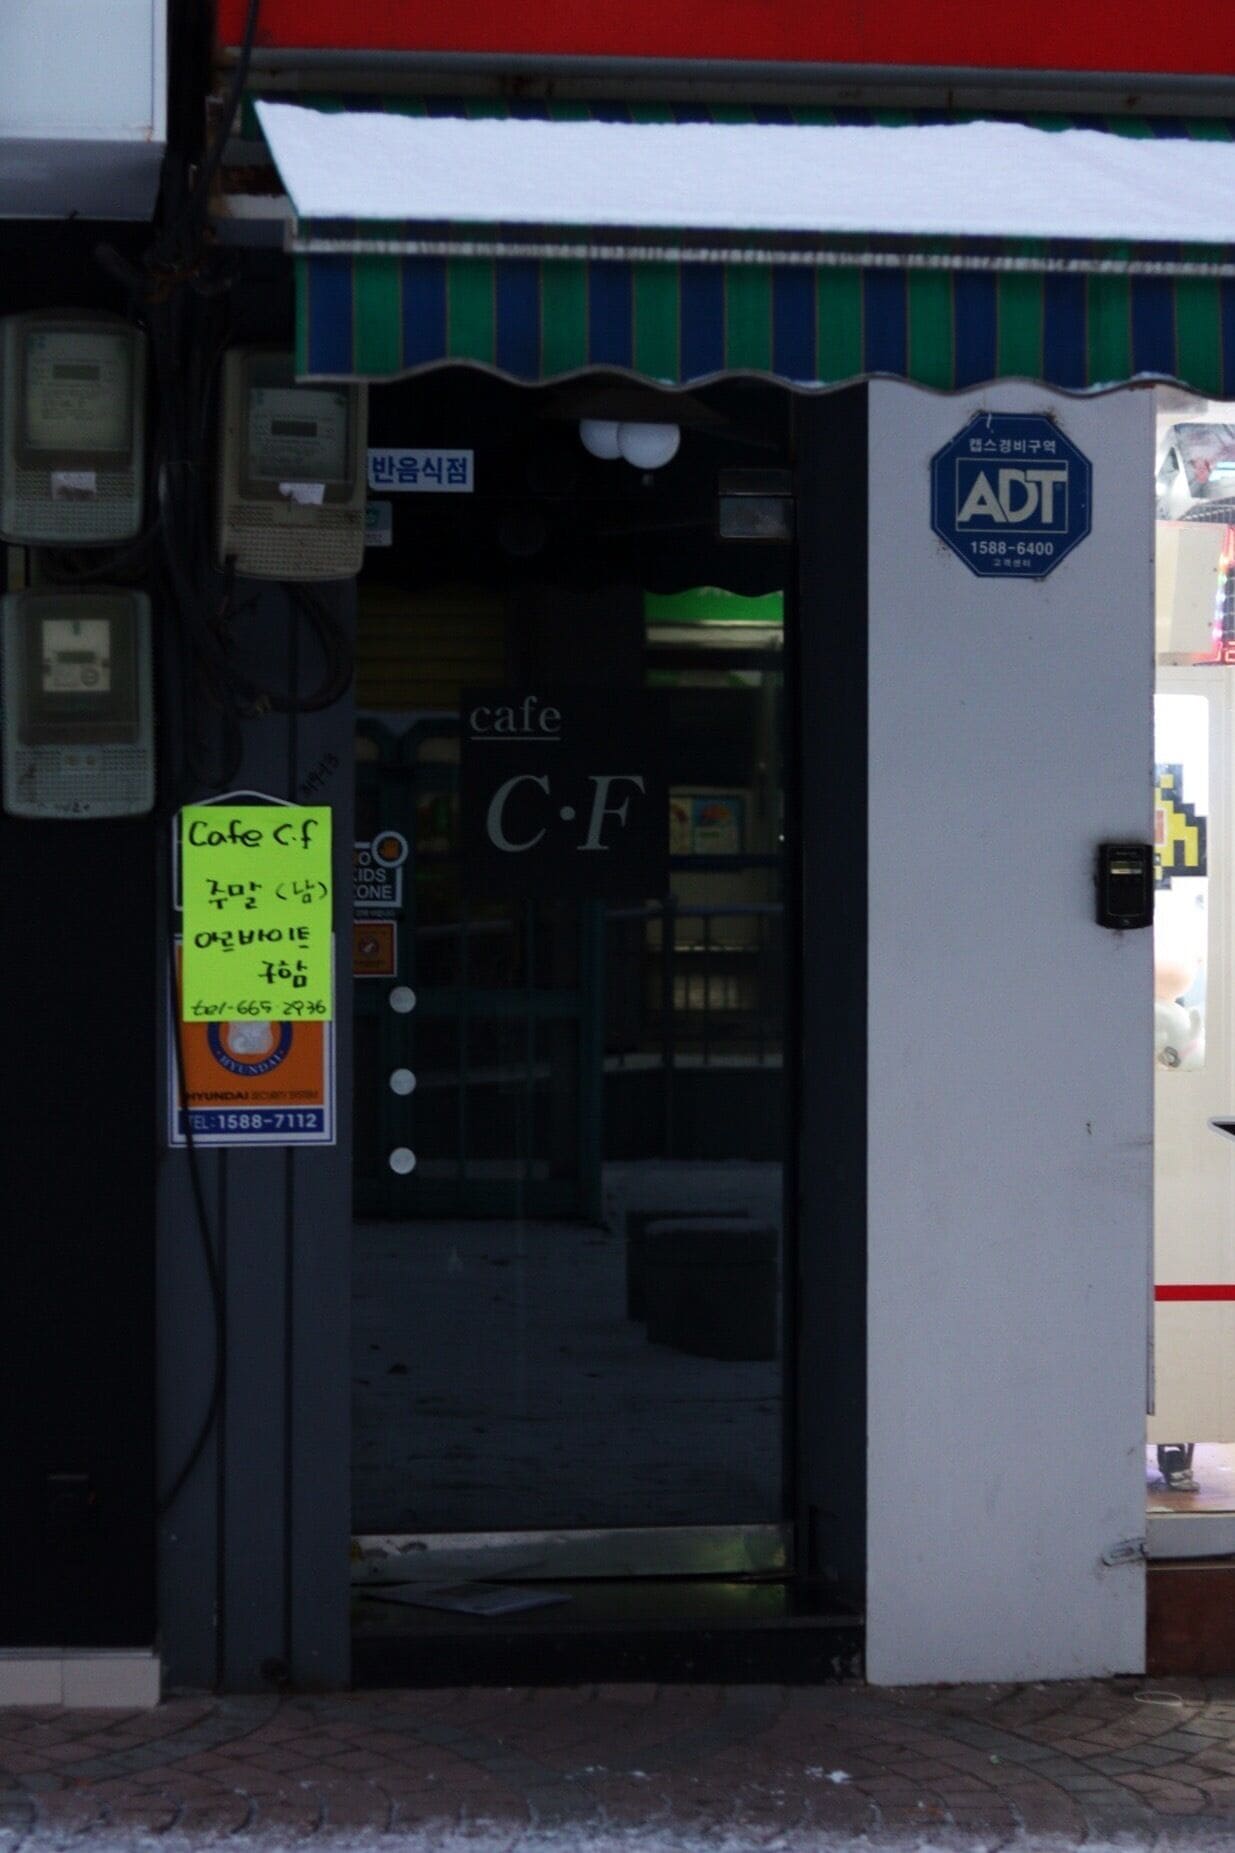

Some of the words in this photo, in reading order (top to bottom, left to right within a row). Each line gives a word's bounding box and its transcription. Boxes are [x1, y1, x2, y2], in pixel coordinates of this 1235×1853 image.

[372, 455, 468, 485] 반음식점
[957, 468, 1069, 525] ADT
[970, 540, 1056, 556] 1588-6400
[469, 695, 563, 734] cafe
[188, 818, 264, 848] Cafe
[207, 878, 262, 910] 주말
[194, 926, 310, 953] 아르바이트
[258, 959, 308, 989] 구함
[217, 1113, 318, 1130] 1588-7112
